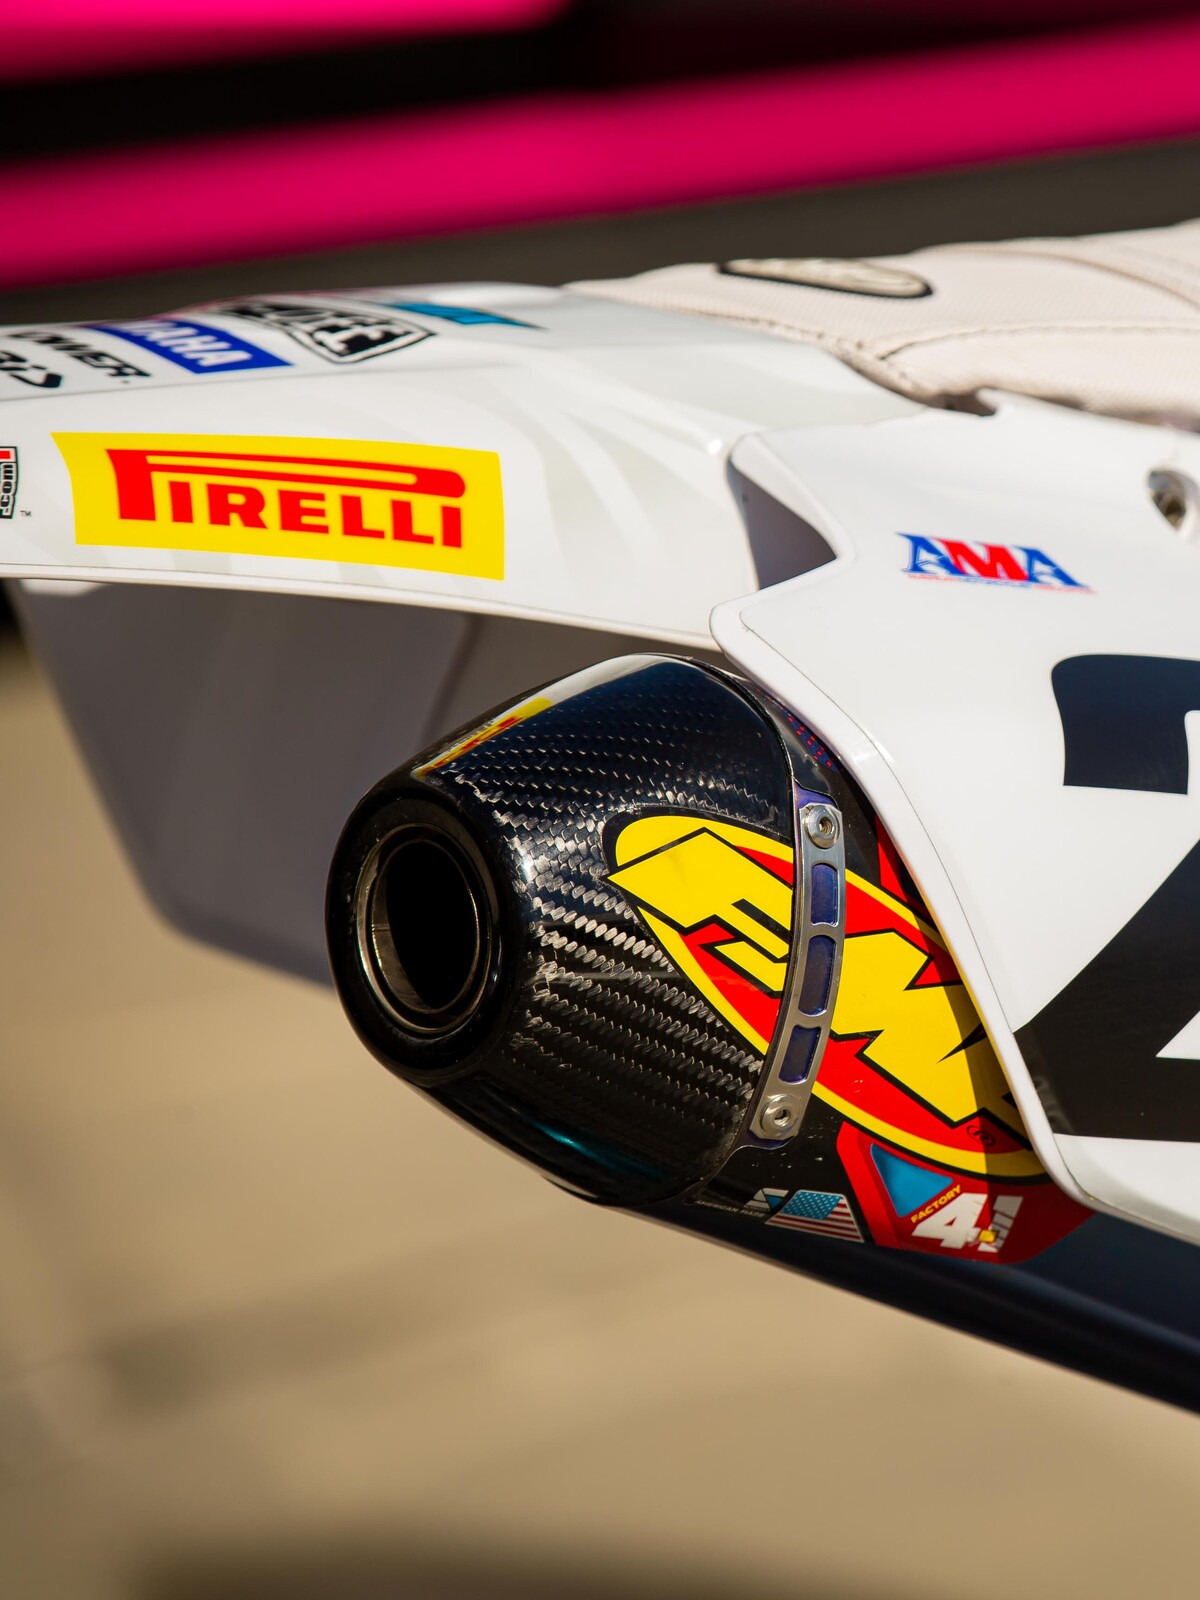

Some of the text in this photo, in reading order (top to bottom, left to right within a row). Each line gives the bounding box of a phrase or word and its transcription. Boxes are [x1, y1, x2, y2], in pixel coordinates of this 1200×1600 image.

[105, 448, 466, 549] PIRELLI
[895, 532, 1091, 590] AMA
[911, 1185, 961, 1223] FACTORY
